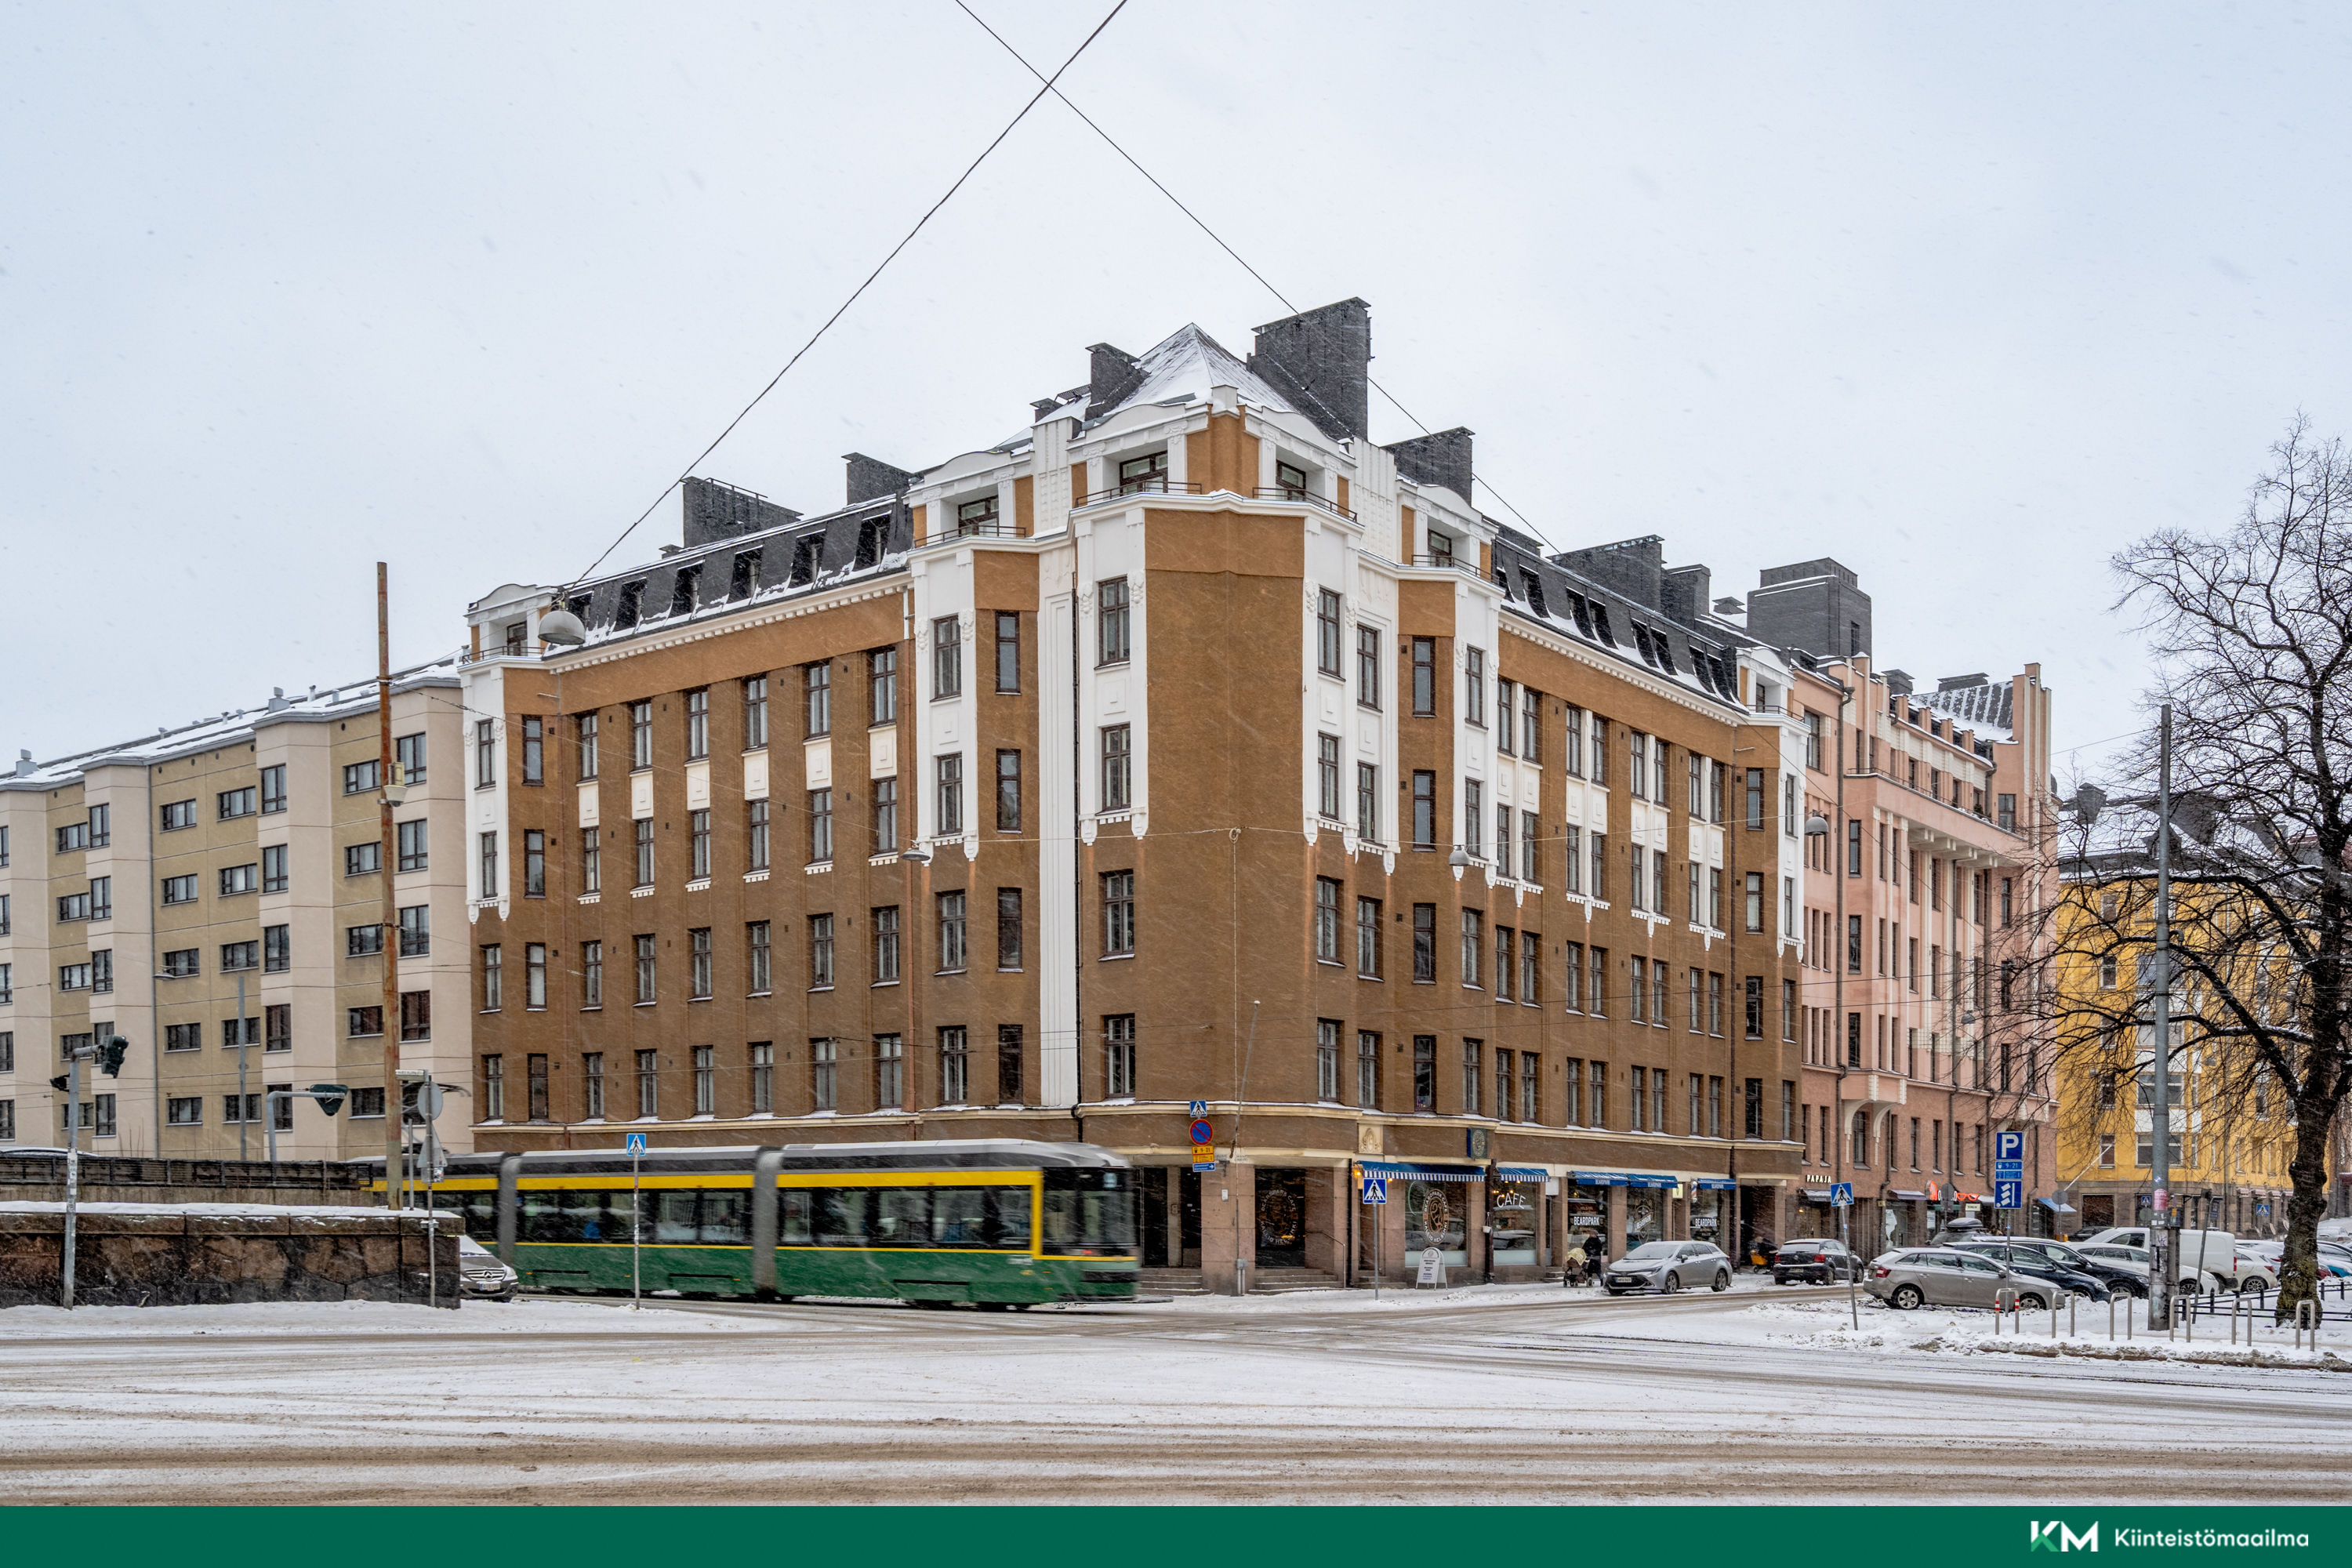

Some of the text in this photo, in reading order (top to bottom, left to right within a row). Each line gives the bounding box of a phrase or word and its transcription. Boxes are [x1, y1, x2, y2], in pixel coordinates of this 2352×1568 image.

[2002, 1134, 2019, 1158] P
[1806, 1174, 1831, 1183] PAPAJA
[1497, 1192, 1526, 1209] CAFE
[1573, 1216, 1600, 1225] BEARDPARK
[1695, 1218, 1718, 1227] BEARDPARK
